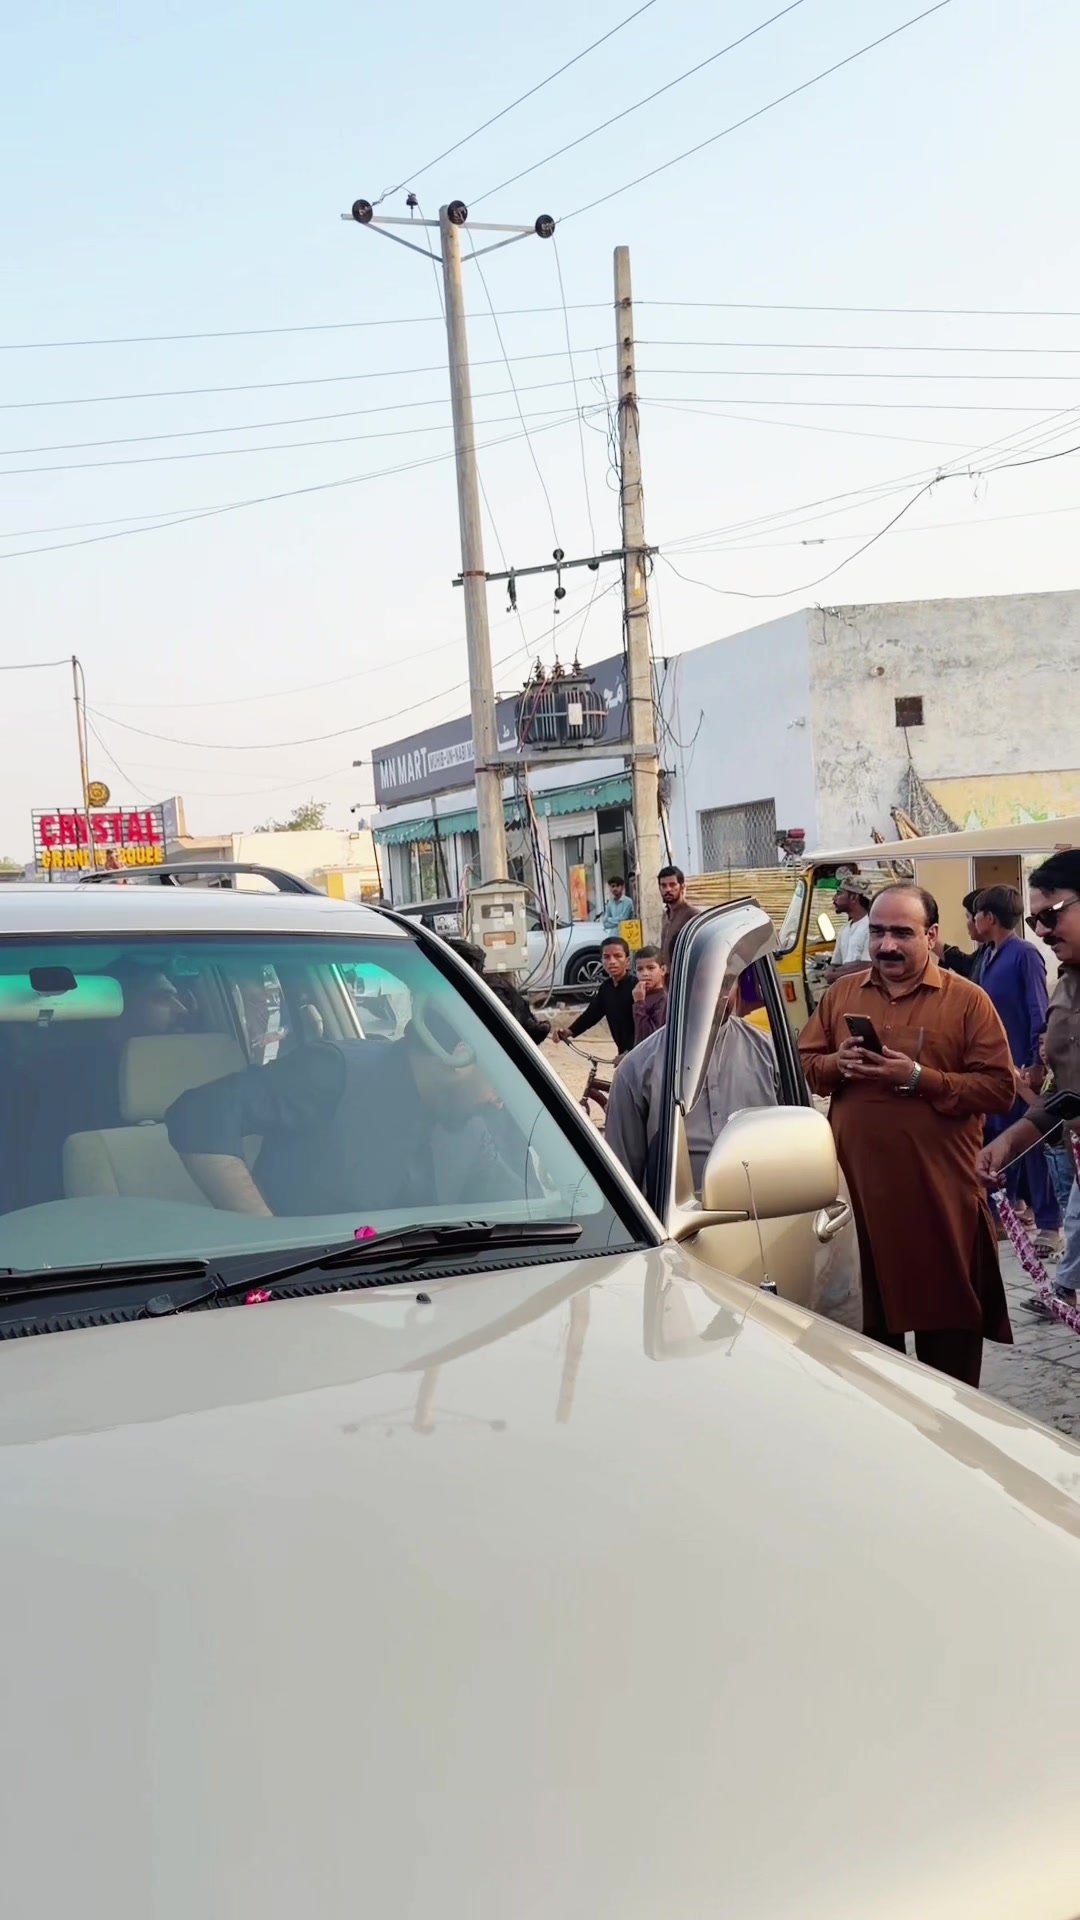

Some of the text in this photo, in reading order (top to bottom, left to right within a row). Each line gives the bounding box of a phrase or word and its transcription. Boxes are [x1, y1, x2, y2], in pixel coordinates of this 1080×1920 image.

[380, 747, 427, 790] MN MART
[40, 812, 161, 846] CRYSTAL
[42, 849, 90, 868] GRAND
